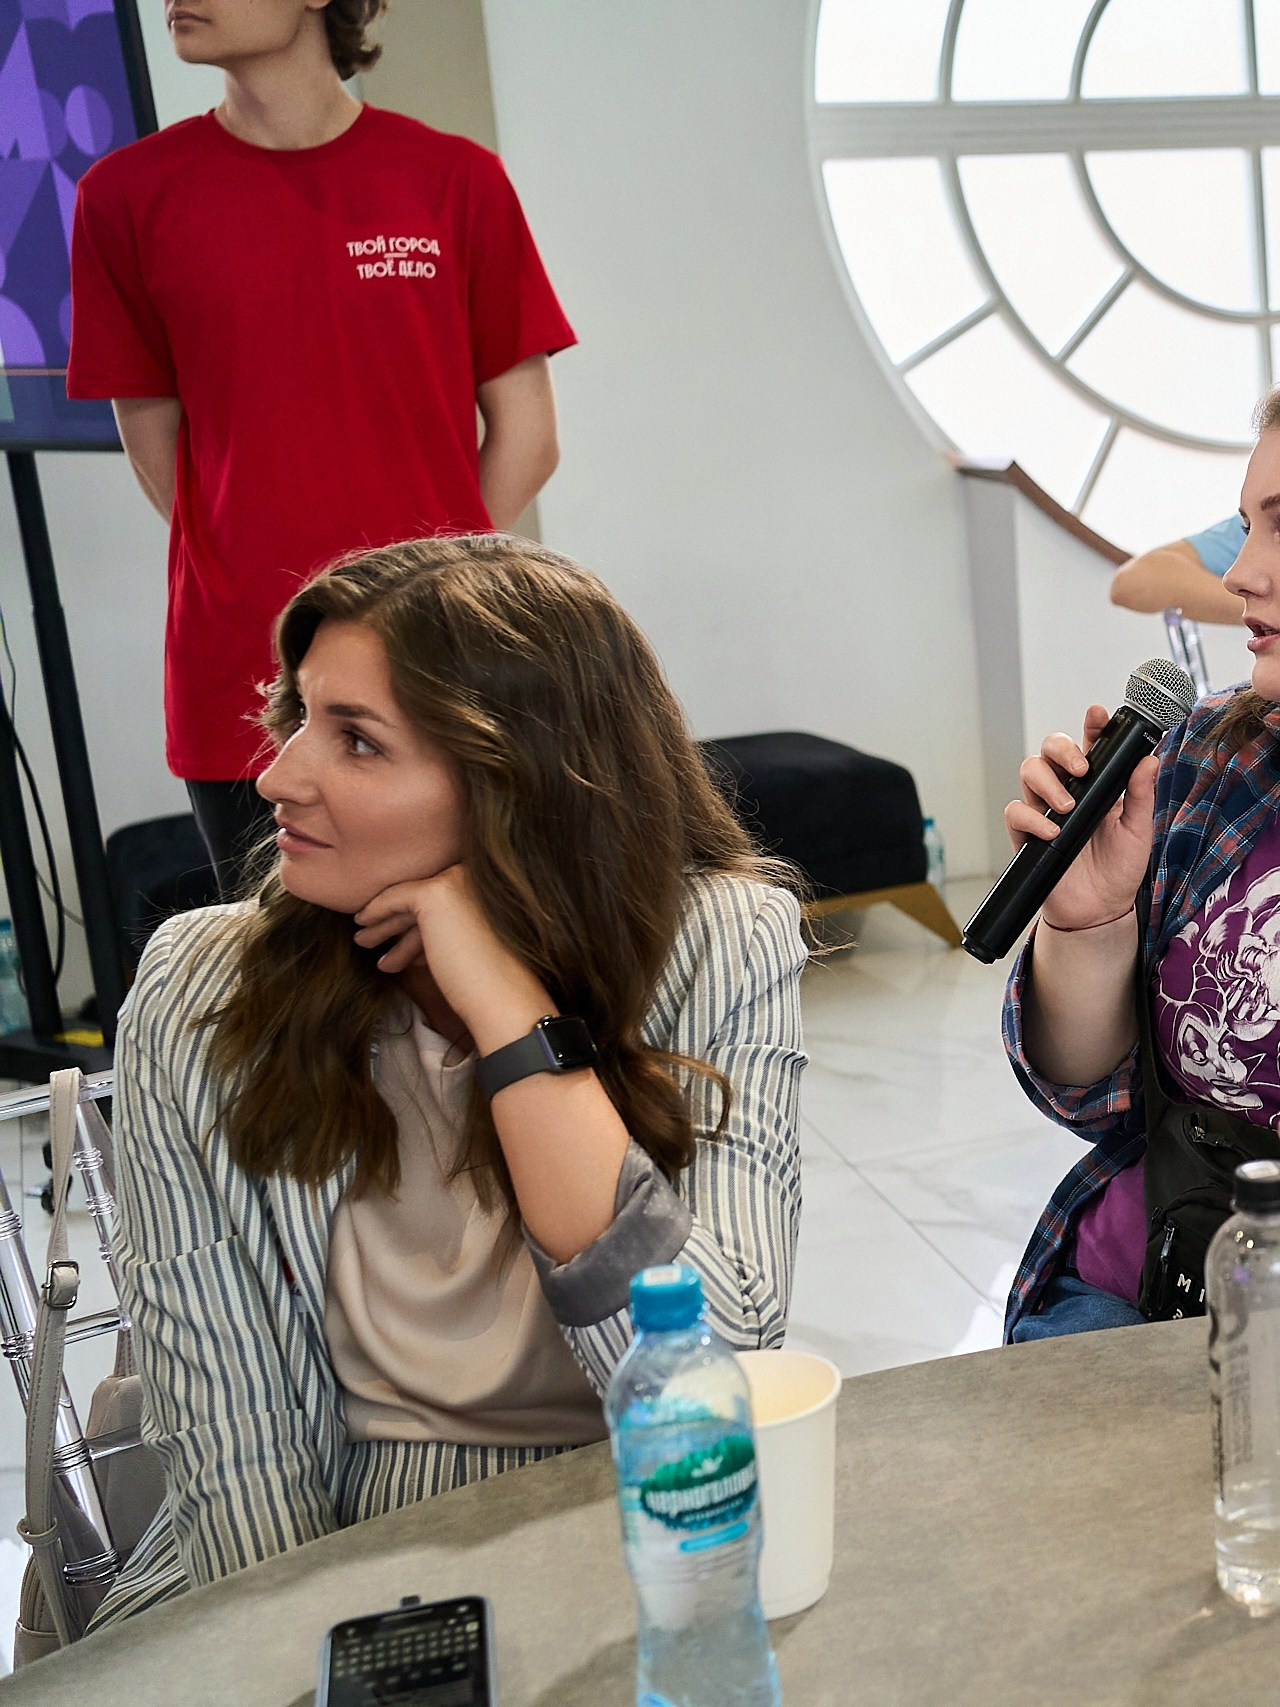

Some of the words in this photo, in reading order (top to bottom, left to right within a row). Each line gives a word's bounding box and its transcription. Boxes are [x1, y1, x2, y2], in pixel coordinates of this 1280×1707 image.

[346, 235, 387, 257] ТВОЙ
[356, 257, 397, 280] ТВОЁ
[398, 260, 437, 279] ДЕЛО
